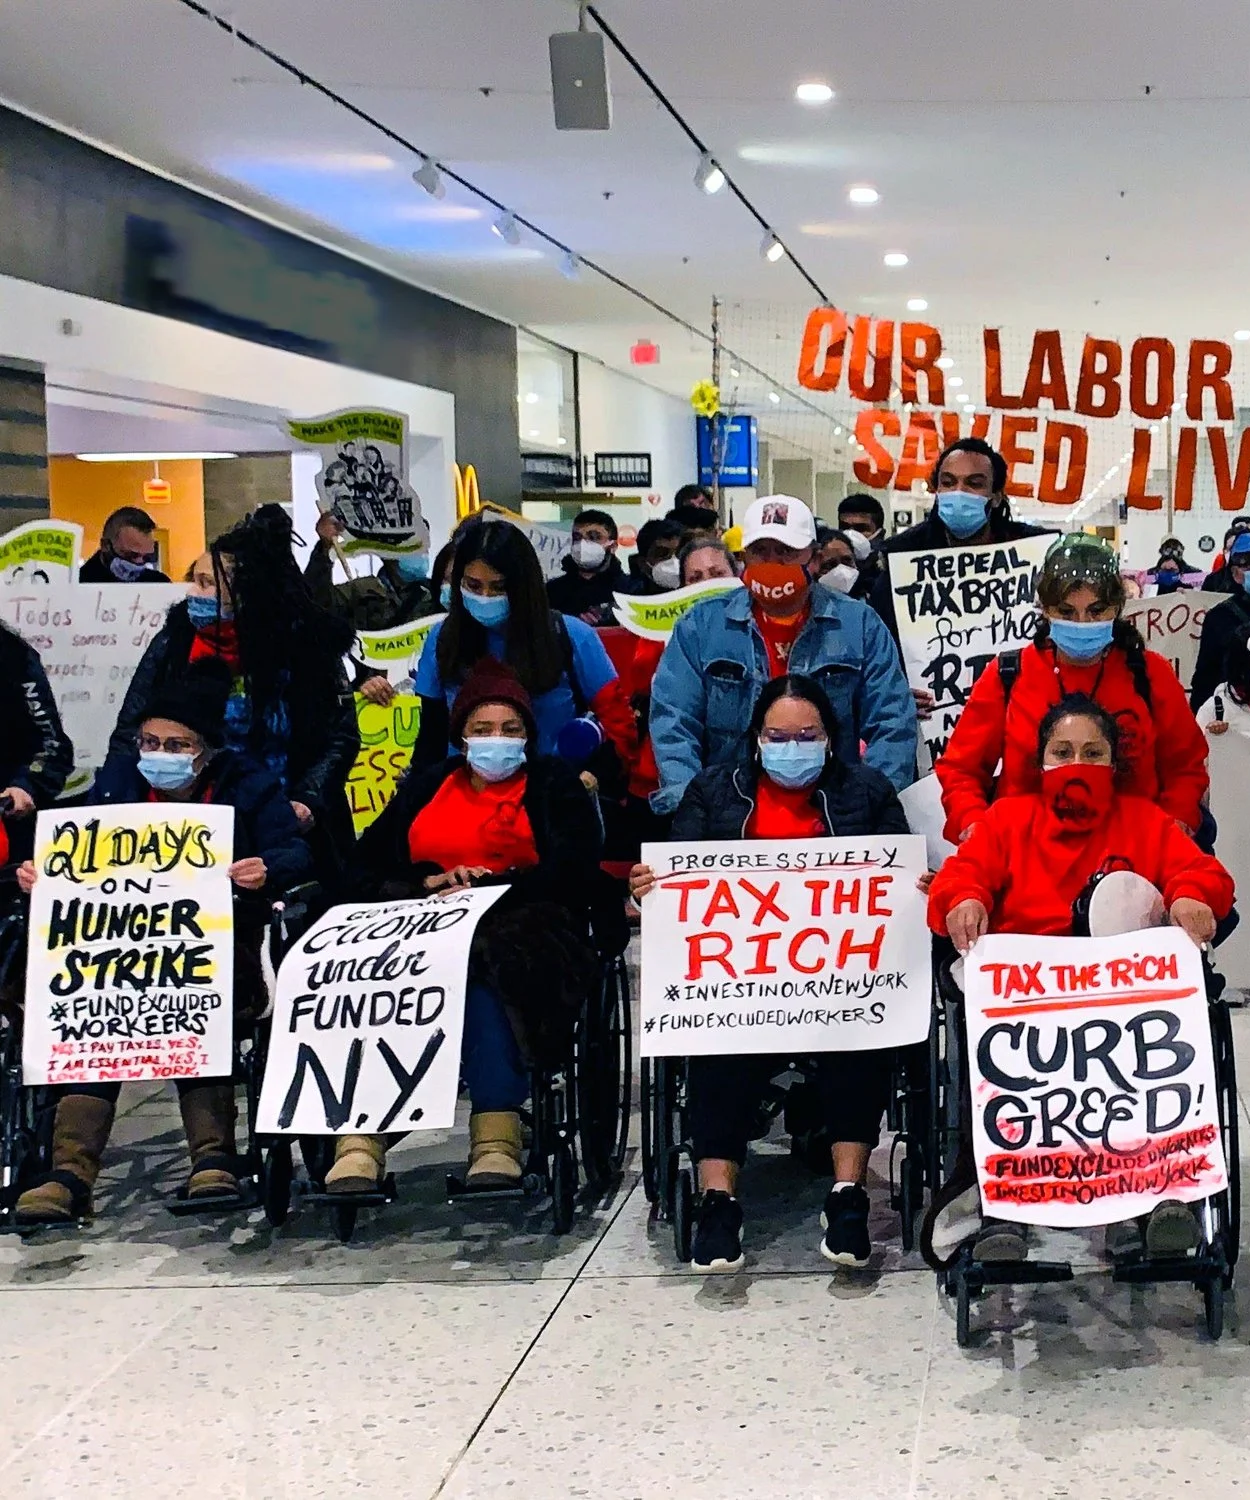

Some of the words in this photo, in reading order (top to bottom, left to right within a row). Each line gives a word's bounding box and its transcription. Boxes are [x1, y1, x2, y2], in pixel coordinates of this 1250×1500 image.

[798, 305, 945, 405] OUR
[983, 325, 1235, 422] LABOR
[302, 422, 334, 433] MAKE
[337, 417, 359, 429] THE
[363, 416, 400, 429] ROAD
[910, 546, 1031, 582] REPEAL
[9, 597, 72, 627] Todos
[95, 591, 117, 623] los
[894, 577, 962, 622] TAX
[72, 634, 117, 647] somos
[374, 633, 414, 653] MAKE
[927, 617, 982, 657] for
[44, 818, 101, 884] 21
[103, 820, 216, 874] DAYS
[669, 847, 905, 872] PROGRESSIVELY
[661, 878, 789, 926] TAX
[804, 875, 894, 917] THE
[47, 898, 205, 949] HUNGER
[305, 940, 432, 990] under
[684, 924, 886, 980] RICH
[980, 961, 1045, 998] TAX
[1050, 963, 1101, 991] THE
[289, 986, 445, 1033] FUNDED
[644, 1002, 886, 1033] #FUNDEXCLUDEDWORKERS
[48, 1060, 57, 1072] I
[62, 1058, 84, 1070] AM
[200, 1054, 210, 1066] I
[79, 1041, 89, 1053] I
[91, 1041, 114, 1053] PAY
[977, 1010, 1196, 1093] CURB
[47, 1070, 91, 1083] LOVE
[99, 1068, 143, 1080] NEW
[983, 1083, 1204, 1157] GREED!
